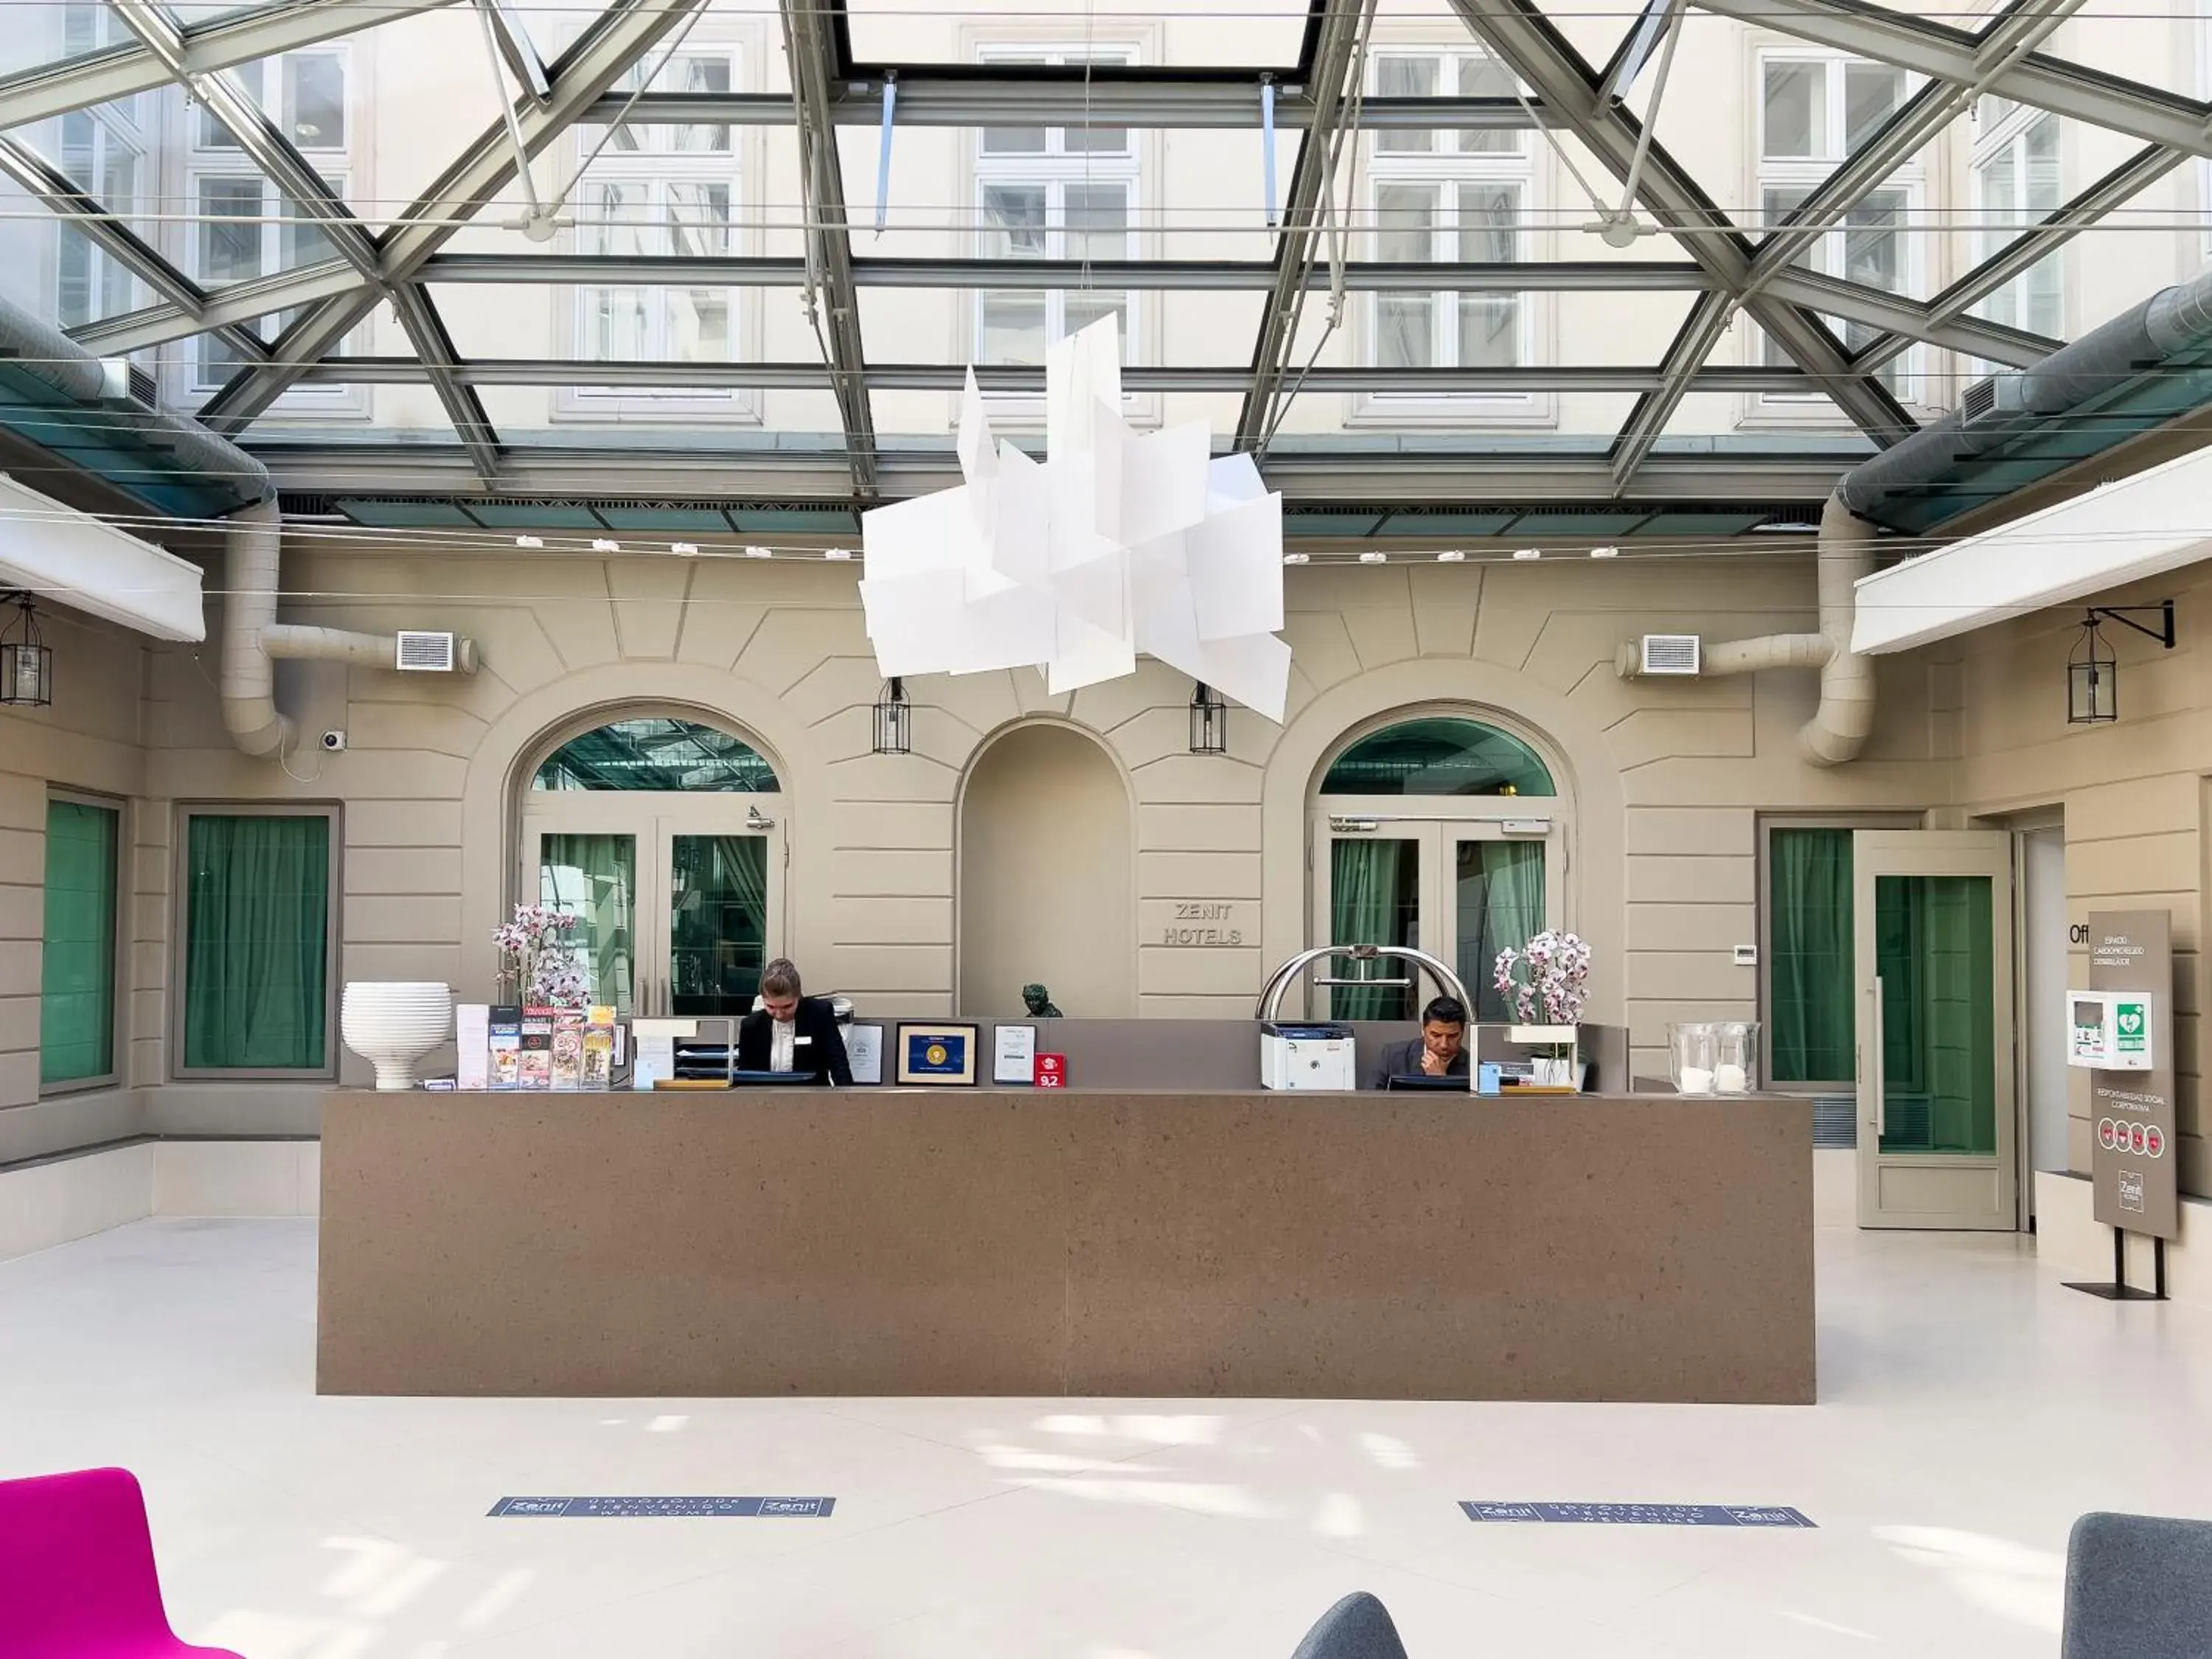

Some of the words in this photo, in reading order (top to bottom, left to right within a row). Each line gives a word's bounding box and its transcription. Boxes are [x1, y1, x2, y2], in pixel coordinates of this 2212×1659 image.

[1175, 903, 1232, 919] ZENIT
[1164, 928, 1242, 945] HOTELS
[1040, 1075, 1058, 1088] 9,2
[2120, 1180, 2143, 1195] Zenit
[510, 1502, 564, 1510] Zenit
[765, 1502, 817, 1510] Zenit
[1479, 1506, 1532, 1516] Zenit
[1732, 1511, 1787, 1520] Zenit
